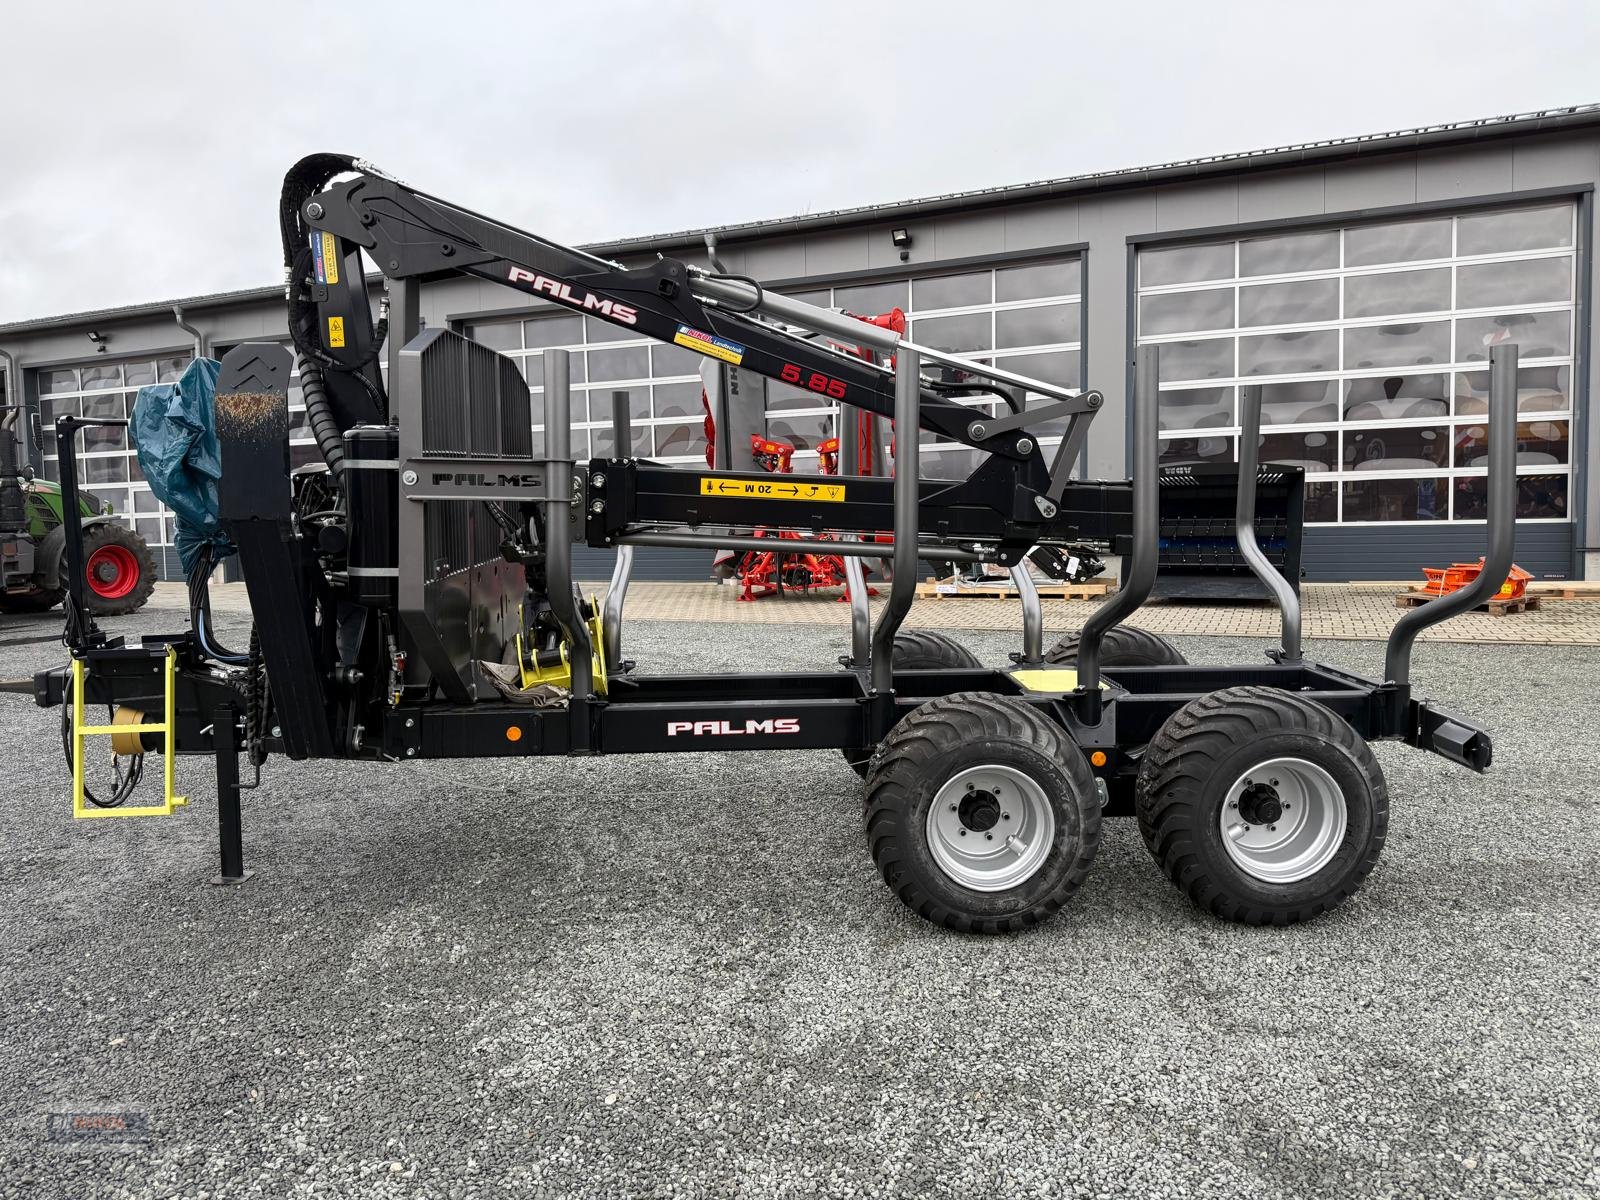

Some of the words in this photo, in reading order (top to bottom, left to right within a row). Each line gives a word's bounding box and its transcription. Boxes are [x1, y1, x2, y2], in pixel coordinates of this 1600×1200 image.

[508, 266, 639, 325] PALMS
[713, 340, 742, 354] Landtechnik
[730, 367, 739, 395] HN
[781, 363, 847, 398] 5.85
[432, 473, 542, 487] PALMS
[745, 484, 755, 493] M
[758, 485, 772, 494] 20
[667, 718, 801, 736] PALMS
